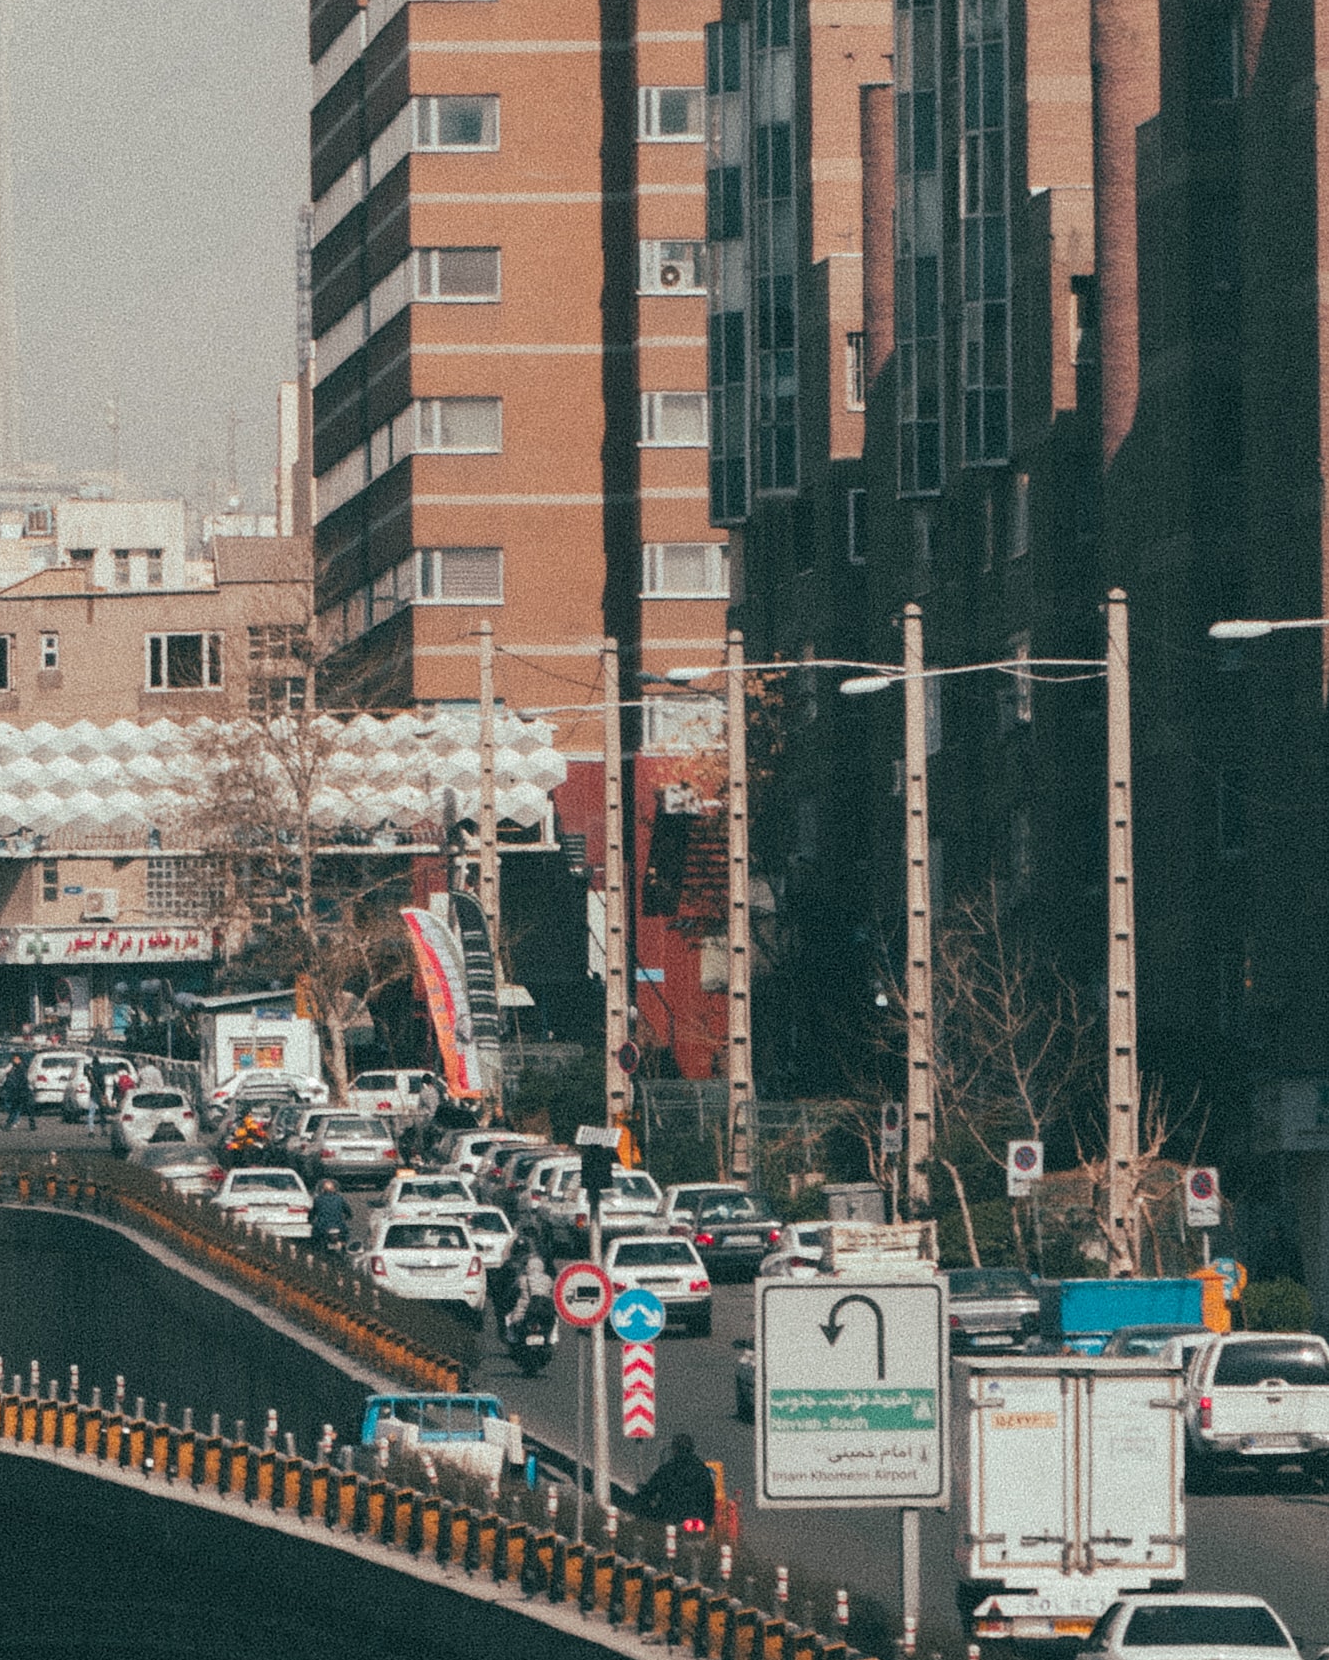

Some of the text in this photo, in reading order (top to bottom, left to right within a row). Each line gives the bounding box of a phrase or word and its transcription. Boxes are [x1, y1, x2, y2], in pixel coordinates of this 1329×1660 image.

[828, 1445, 912, 1464] امام خمینی
[875, 1469, 918, 1483] Airport
